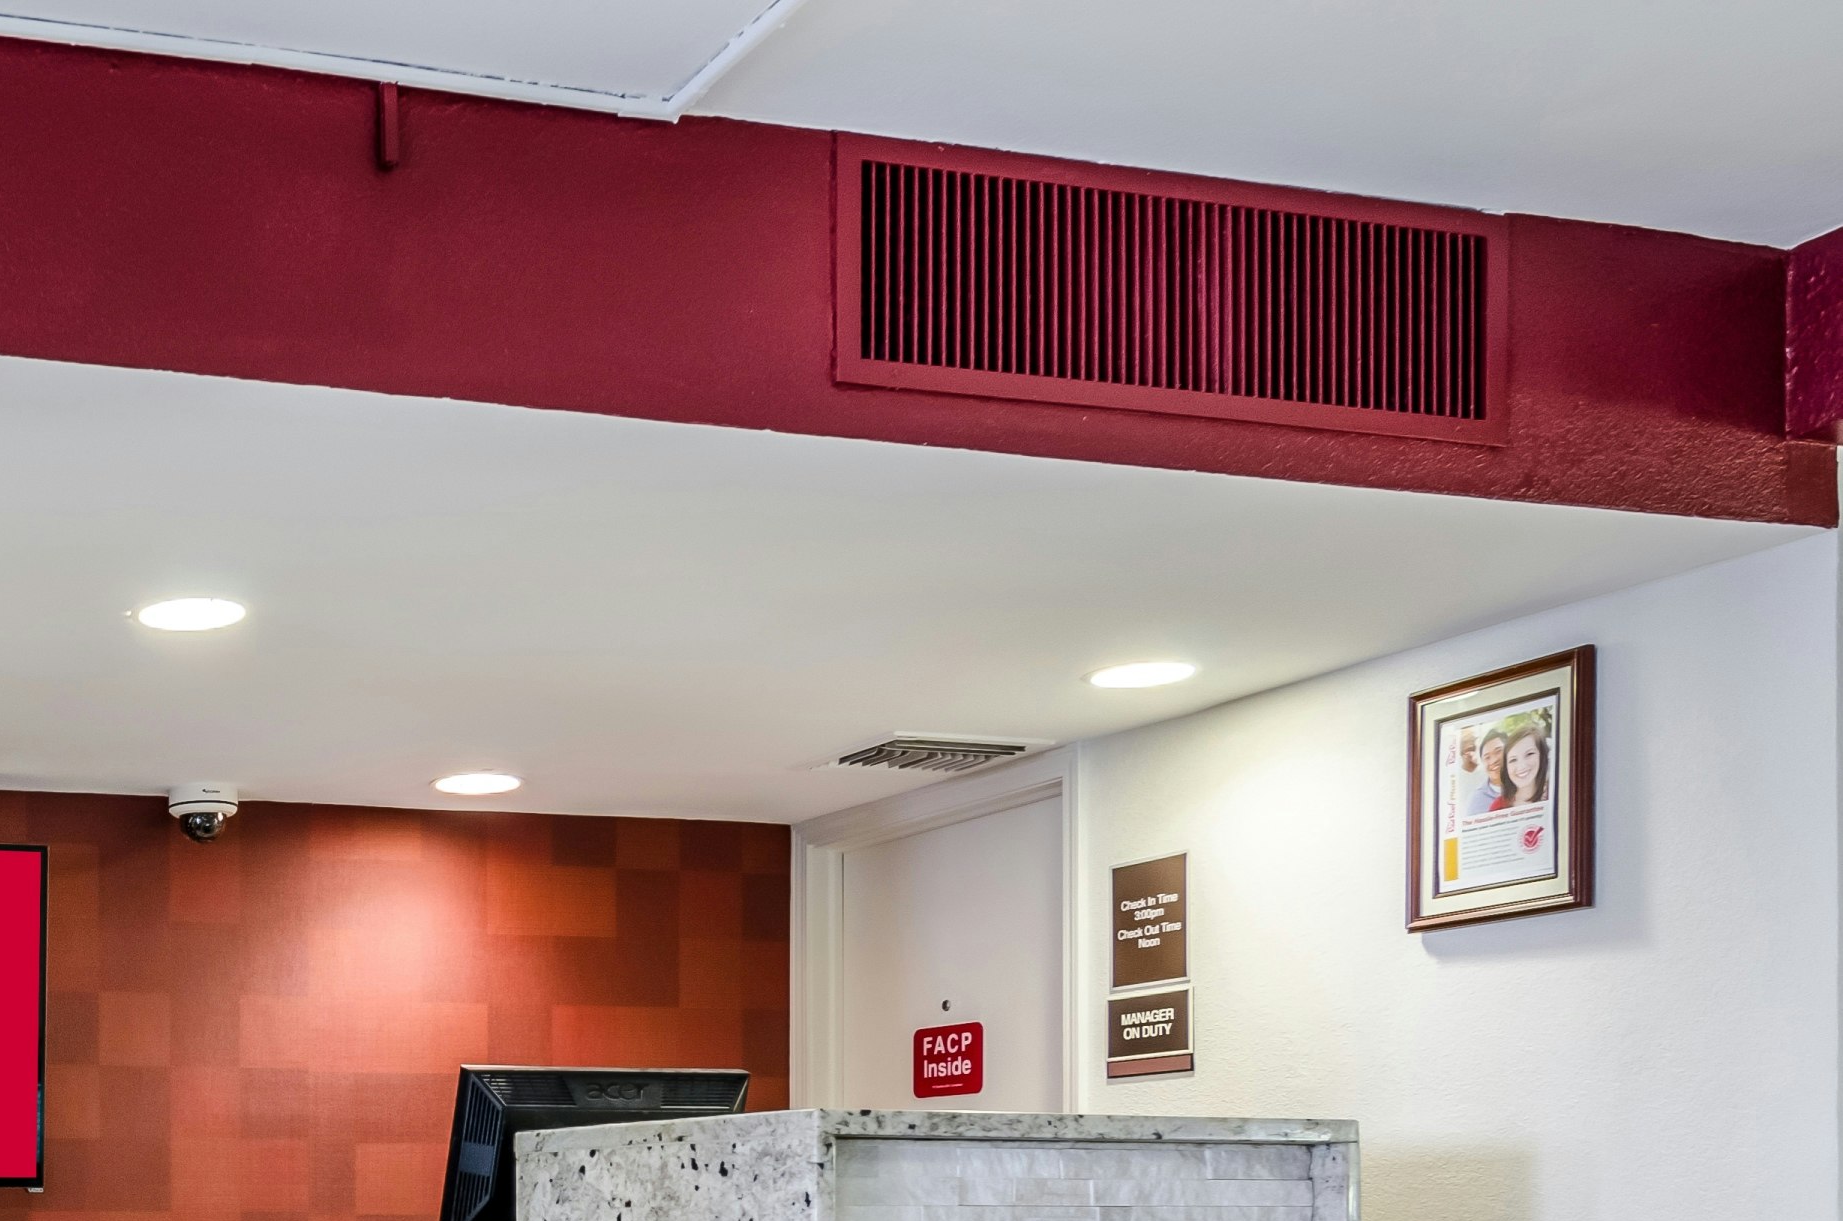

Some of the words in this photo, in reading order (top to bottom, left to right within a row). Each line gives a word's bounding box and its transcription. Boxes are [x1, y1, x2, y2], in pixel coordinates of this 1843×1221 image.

[1120, 898, 1146, 911] Check
[1147, 896, 1156, 907] In
[1156, 893, 1178, 904] Time
[1117, 927, 1143, 940] Check
[1144, 924, 1160, 936] Out
[1160, 921, 1182, 933] Time
[1137, 937, 1161, 949] Noon
[1120, 1007, 1175, 1026] MANAGER
[1122, 1026, 1141, 1041] ON
[1141, 1022, 1173, 1038] DUTY
[923, 1032, 973, 1056] FACP
[923, 1056, 972, 1078] Inside
[585, 1082, 649, 1101] acer
